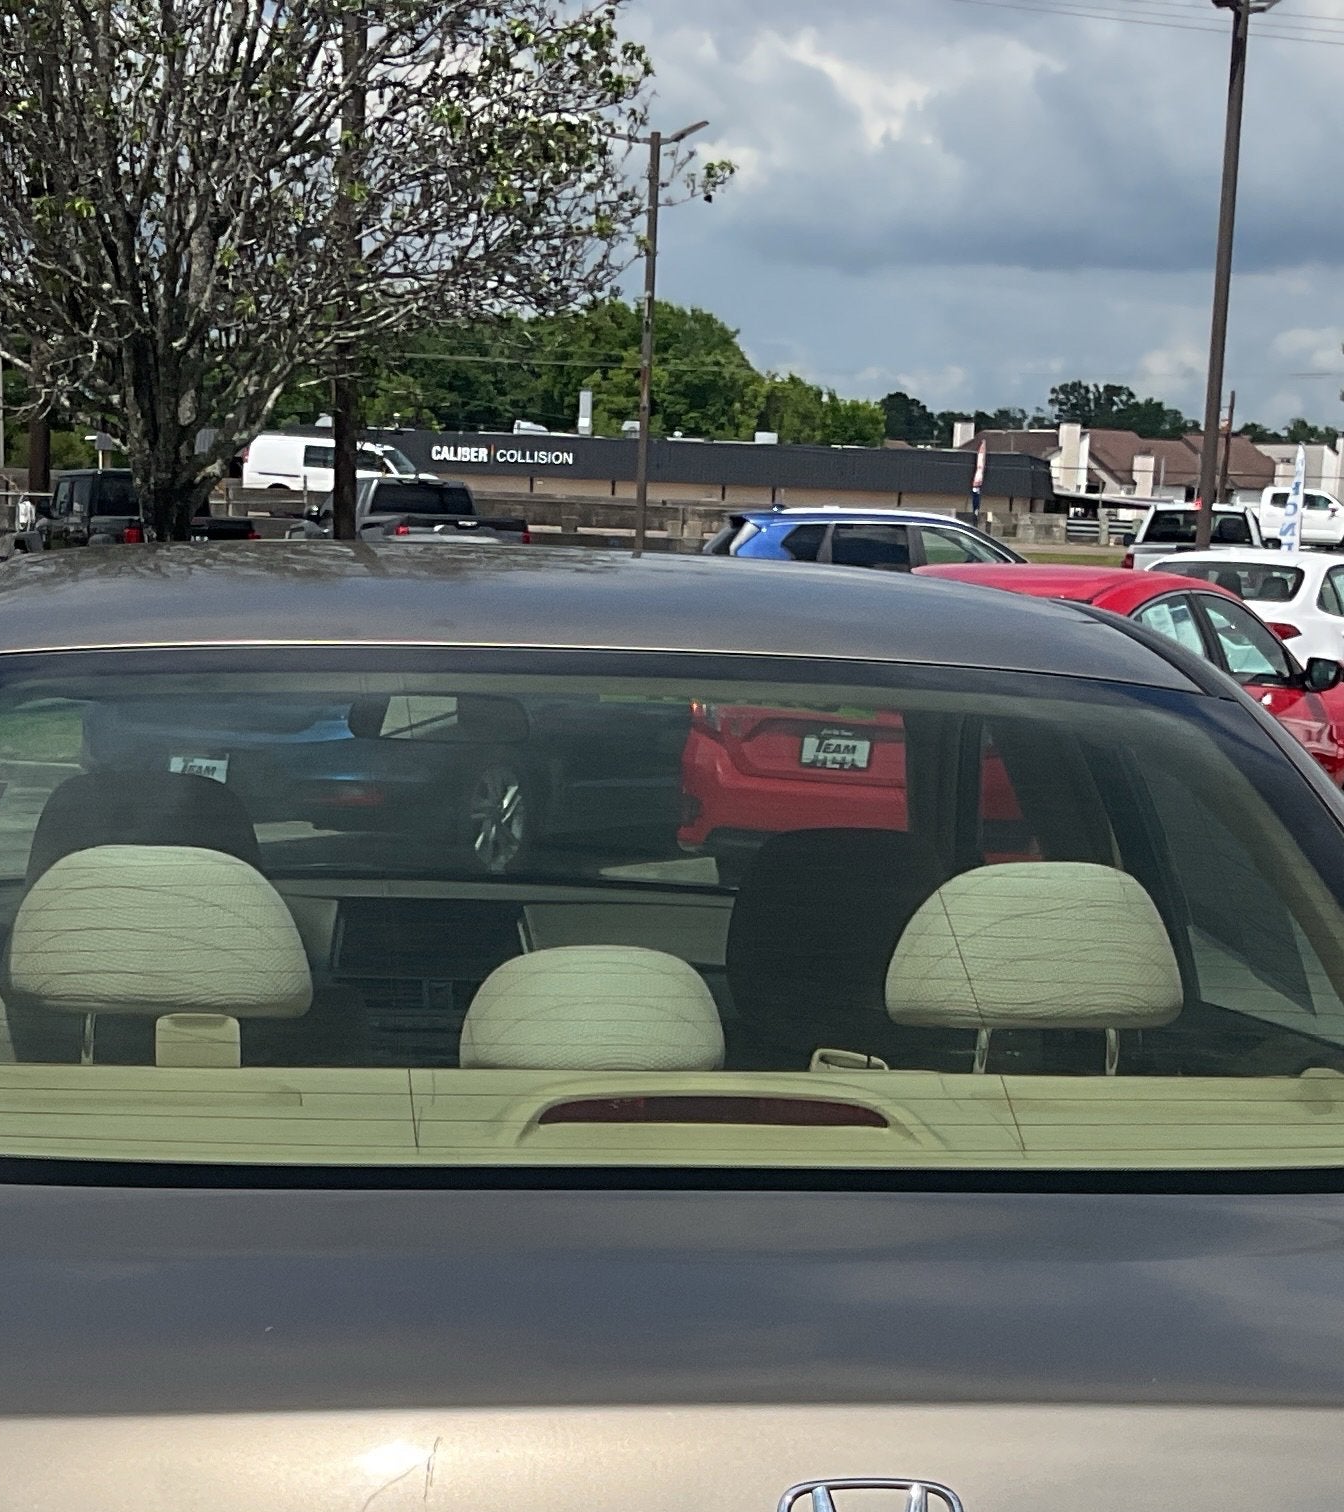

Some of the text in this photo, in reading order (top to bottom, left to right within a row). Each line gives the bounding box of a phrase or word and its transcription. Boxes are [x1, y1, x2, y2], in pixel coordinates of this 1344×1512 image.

[431, 445, 573, 465] CALIBER COLLISION
[815, 736, 858, 755] TEAM
